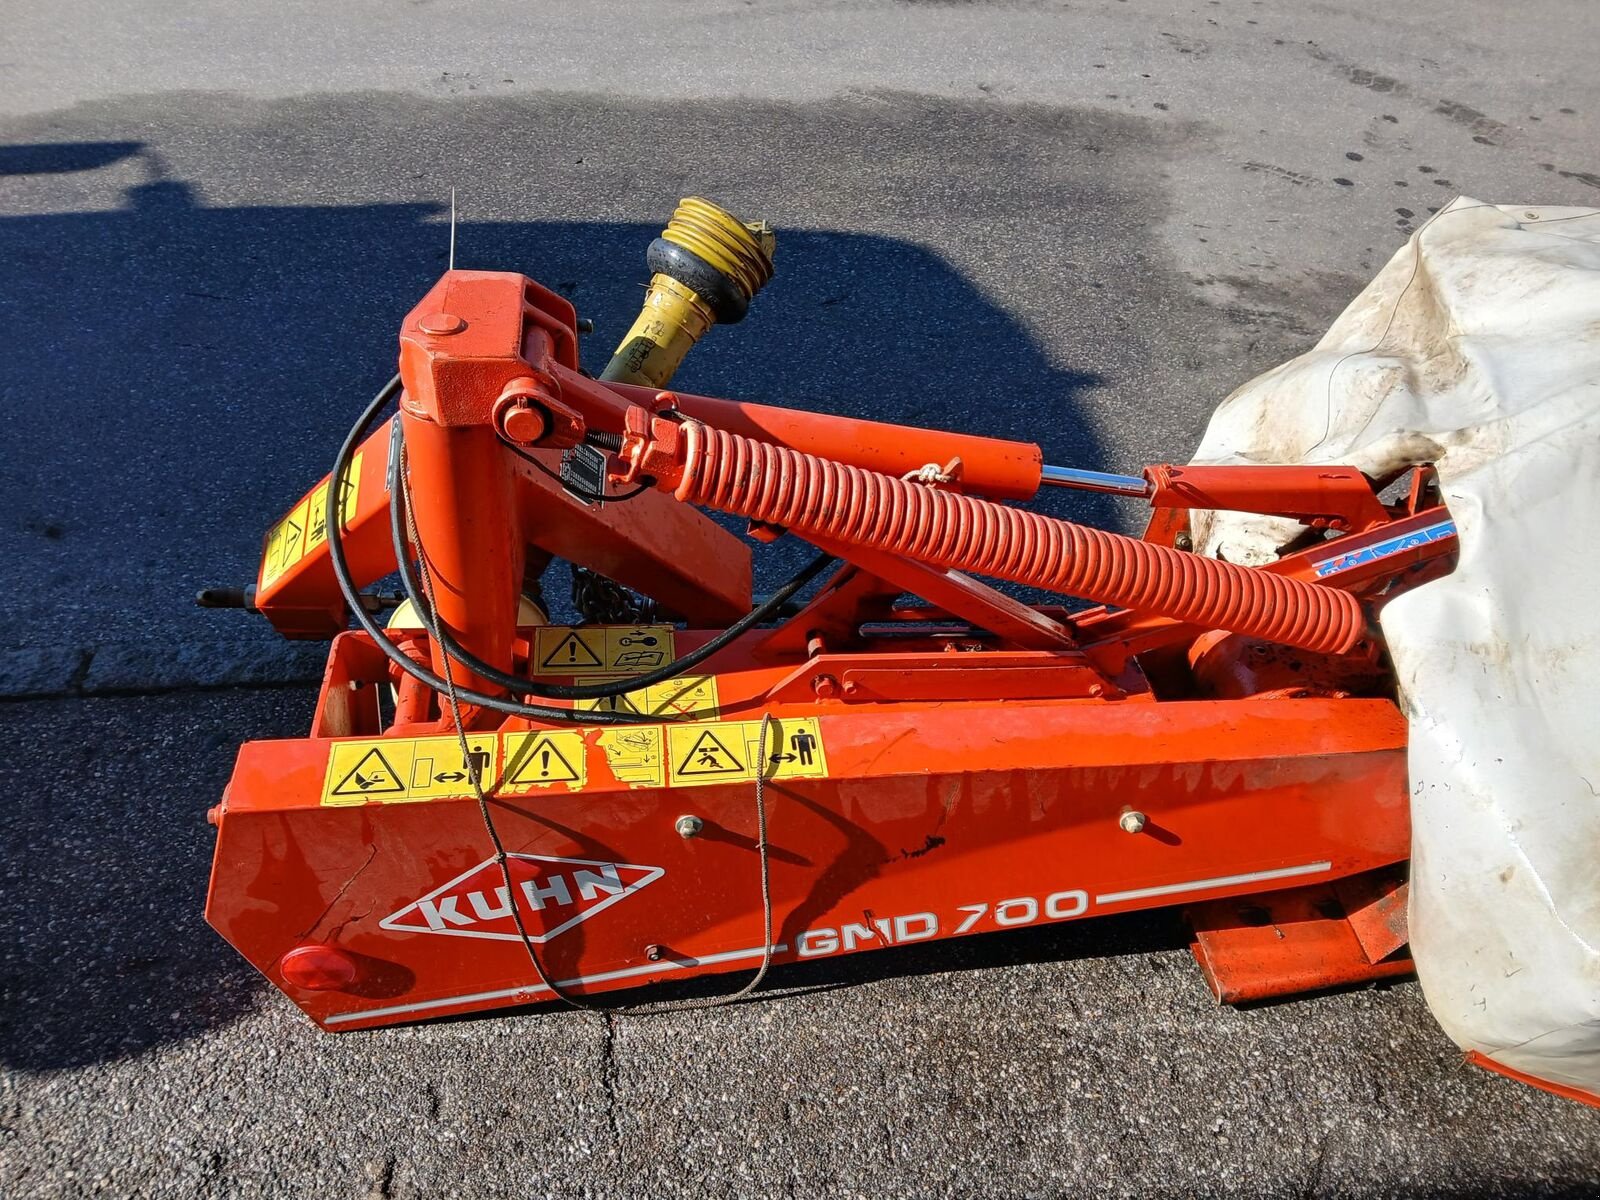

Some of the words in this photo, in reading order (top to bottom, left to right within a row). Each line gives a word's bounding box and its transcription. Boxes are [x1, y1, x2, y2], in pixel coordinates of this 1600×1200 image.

[417, 863, 625, 931] KUHN
[796, 911, 939, 958] GMD
[954, 889, 1089, 935] 700
